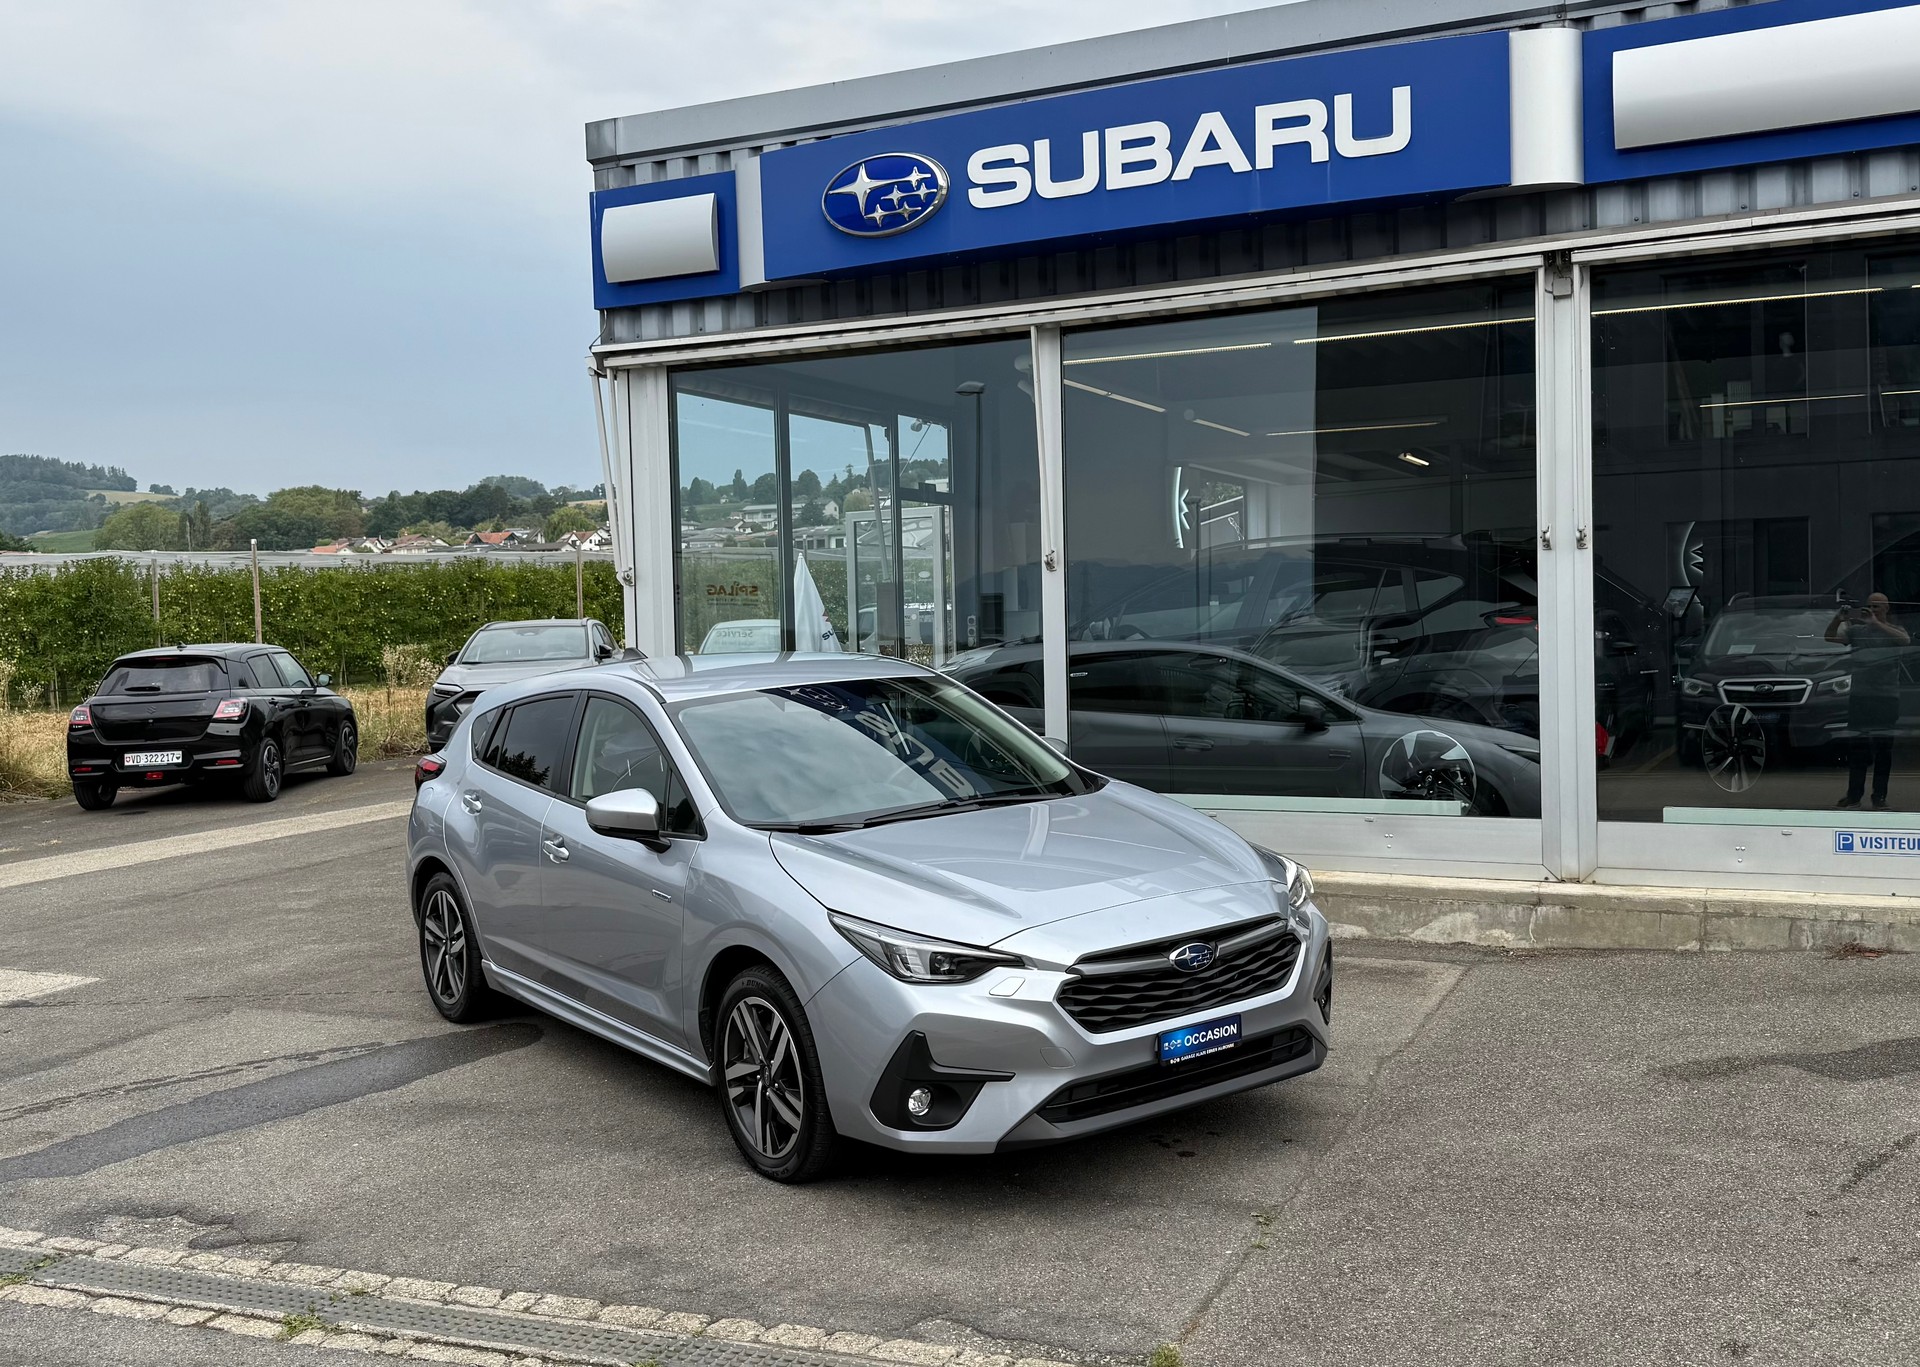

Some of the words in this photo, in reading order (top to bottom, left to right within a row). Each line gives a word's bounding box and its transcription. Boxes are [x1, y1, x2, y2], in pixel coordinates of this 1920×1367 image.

[967, 85, 1412, 209] SUBARU
[131, 754, 141, 764] VD
[1840, 834, 1852, 850] P
[1184, 1023, 1237, 1047] OCCASION
